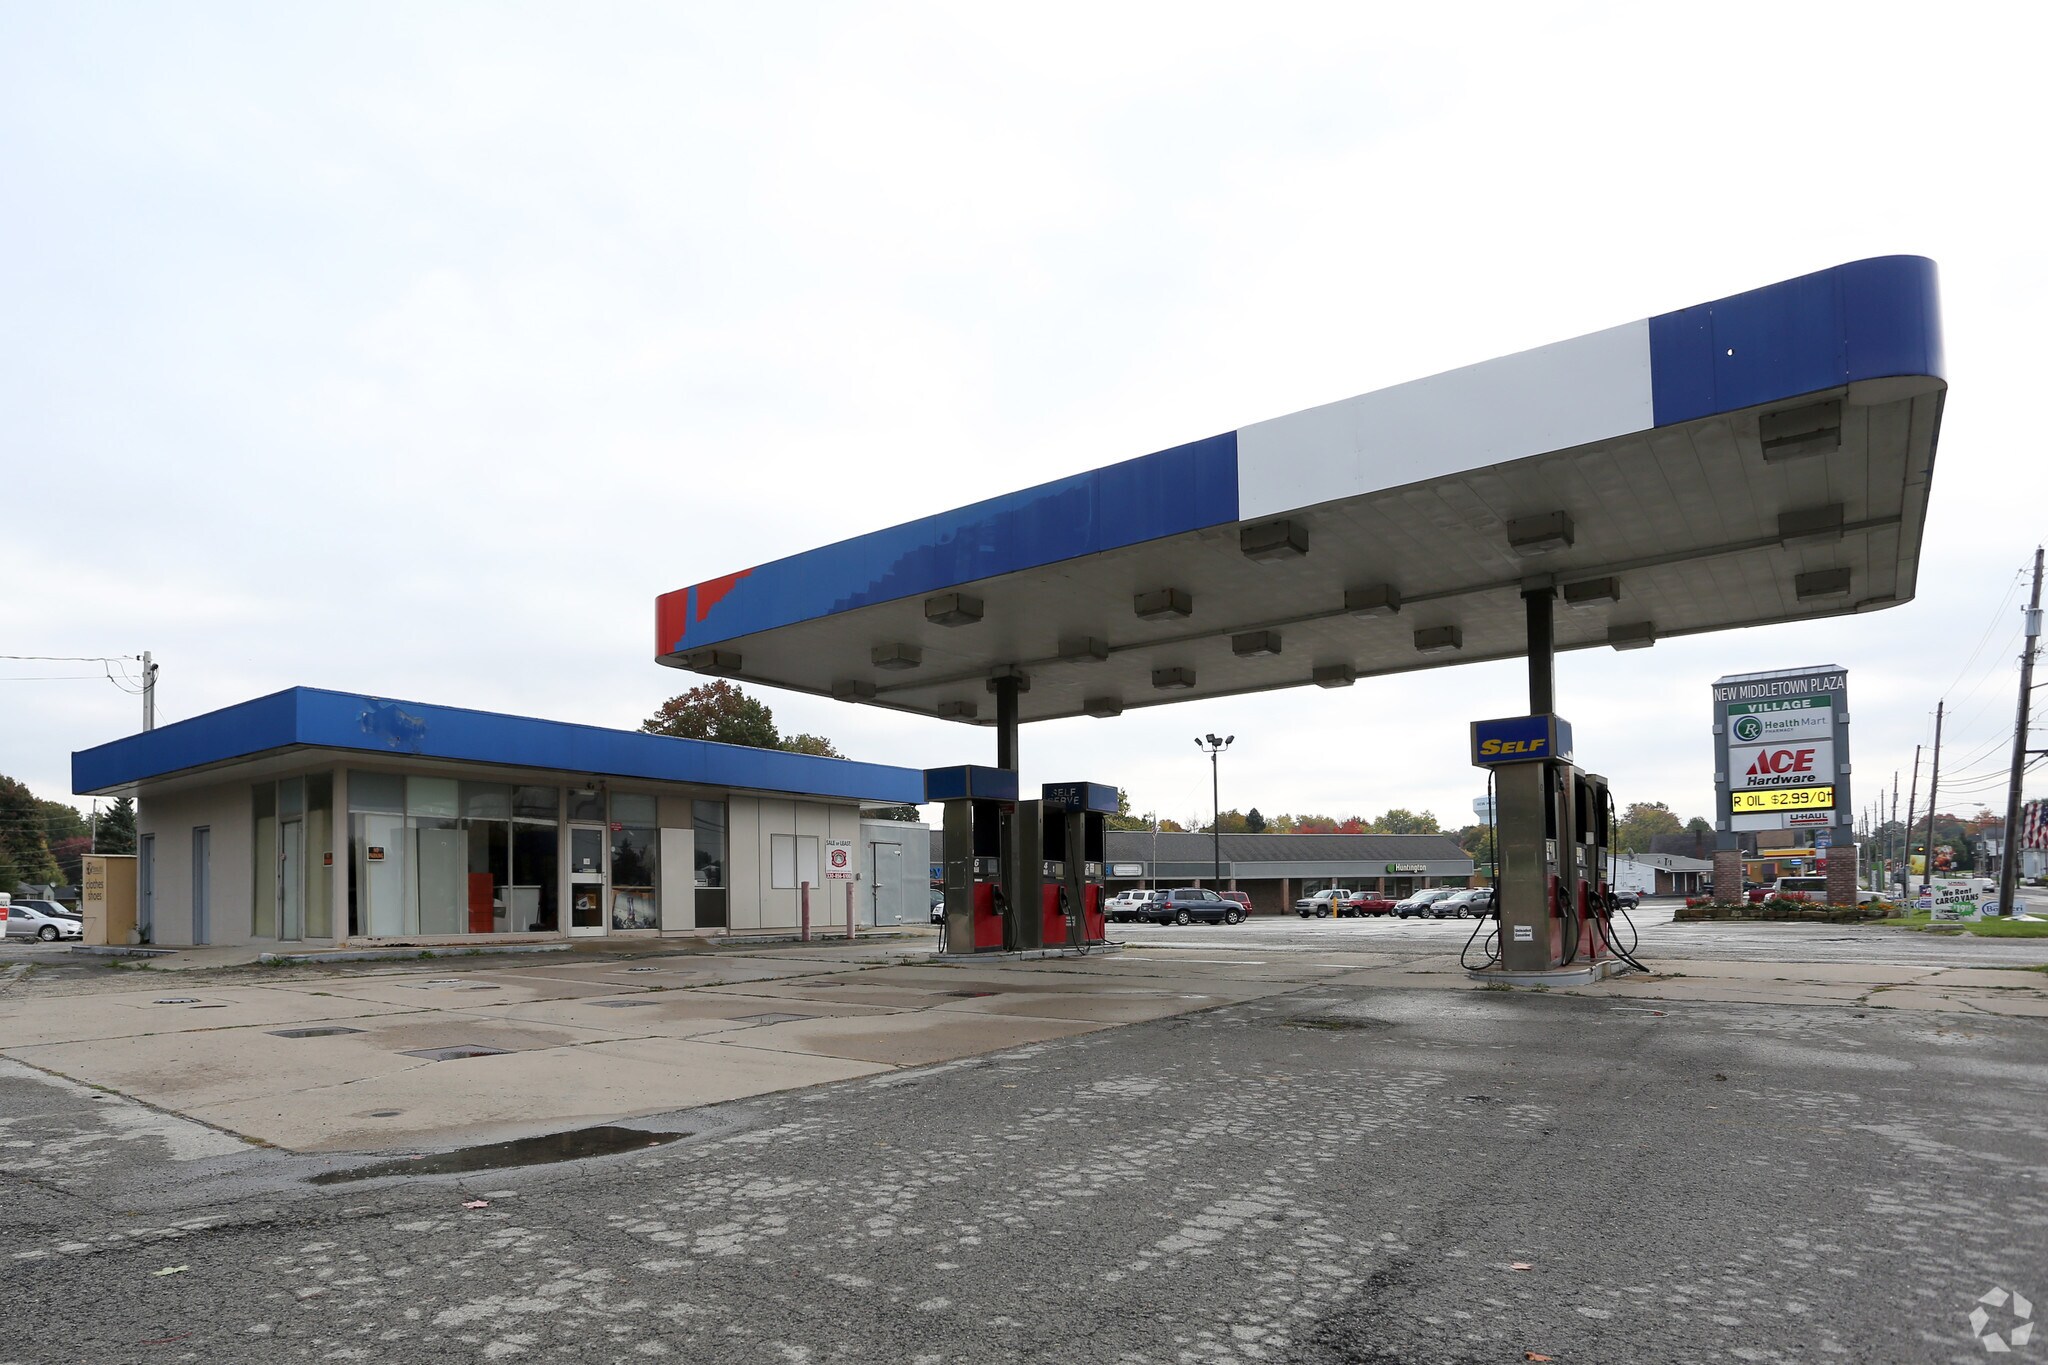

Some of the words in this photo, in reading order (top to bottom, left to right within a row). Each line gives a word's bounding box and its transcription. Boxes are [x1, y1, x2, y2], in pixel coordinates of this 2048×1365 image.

[1715, 687, 1737, 702] NEW
[1740, 681, 1808, 699] MIDDLETOWN
[1811, 675, 1844, 693] PLAZA
[1748, 699, 1811, 713] VILLAGE
[1765, 719, 1799, 729] Health
[1801, 717, 1826, 726] Mart
[1479, 738, 1546, 755] SELF
[1746, 749, 1815, 775] ACE
[1747, 774, 1816, 786] Hardware
[1051, 788, 1076, 797] SELF
[1747, 795, 1765, 806] OIL
[1396, 863, 1427, 873] Huntington
[86, 879, 103, 889] clothes
[88, 890, 102, 901] shoes
[1955, 888, 1972, 896] Rent
[1935, 896, 1959, 905] CARGO
[1960, 893, 1979, 902] VANS
